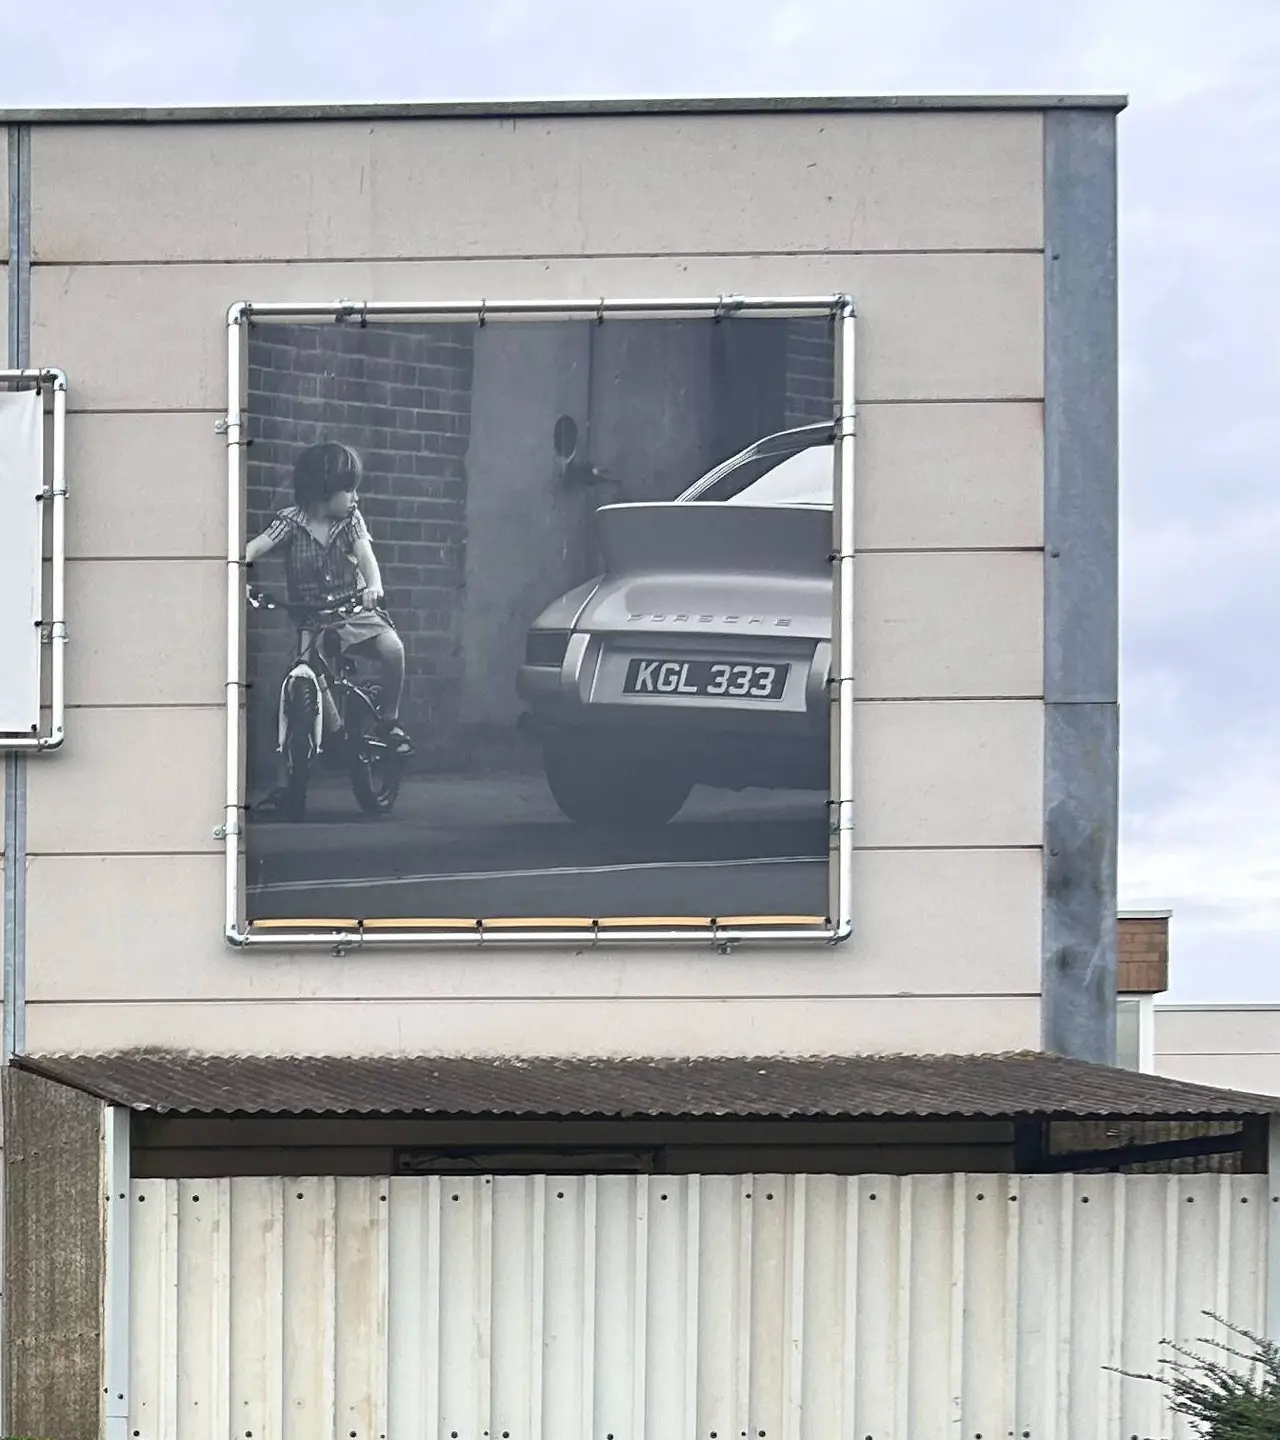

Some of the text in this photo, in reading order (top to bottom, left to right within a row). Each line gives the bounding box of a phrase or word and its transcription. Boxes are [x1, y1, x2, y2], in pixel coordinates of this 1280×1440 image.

[626, 612, 793, 627] PORSCHE
[634, 661, 776, 697] KGL 333
